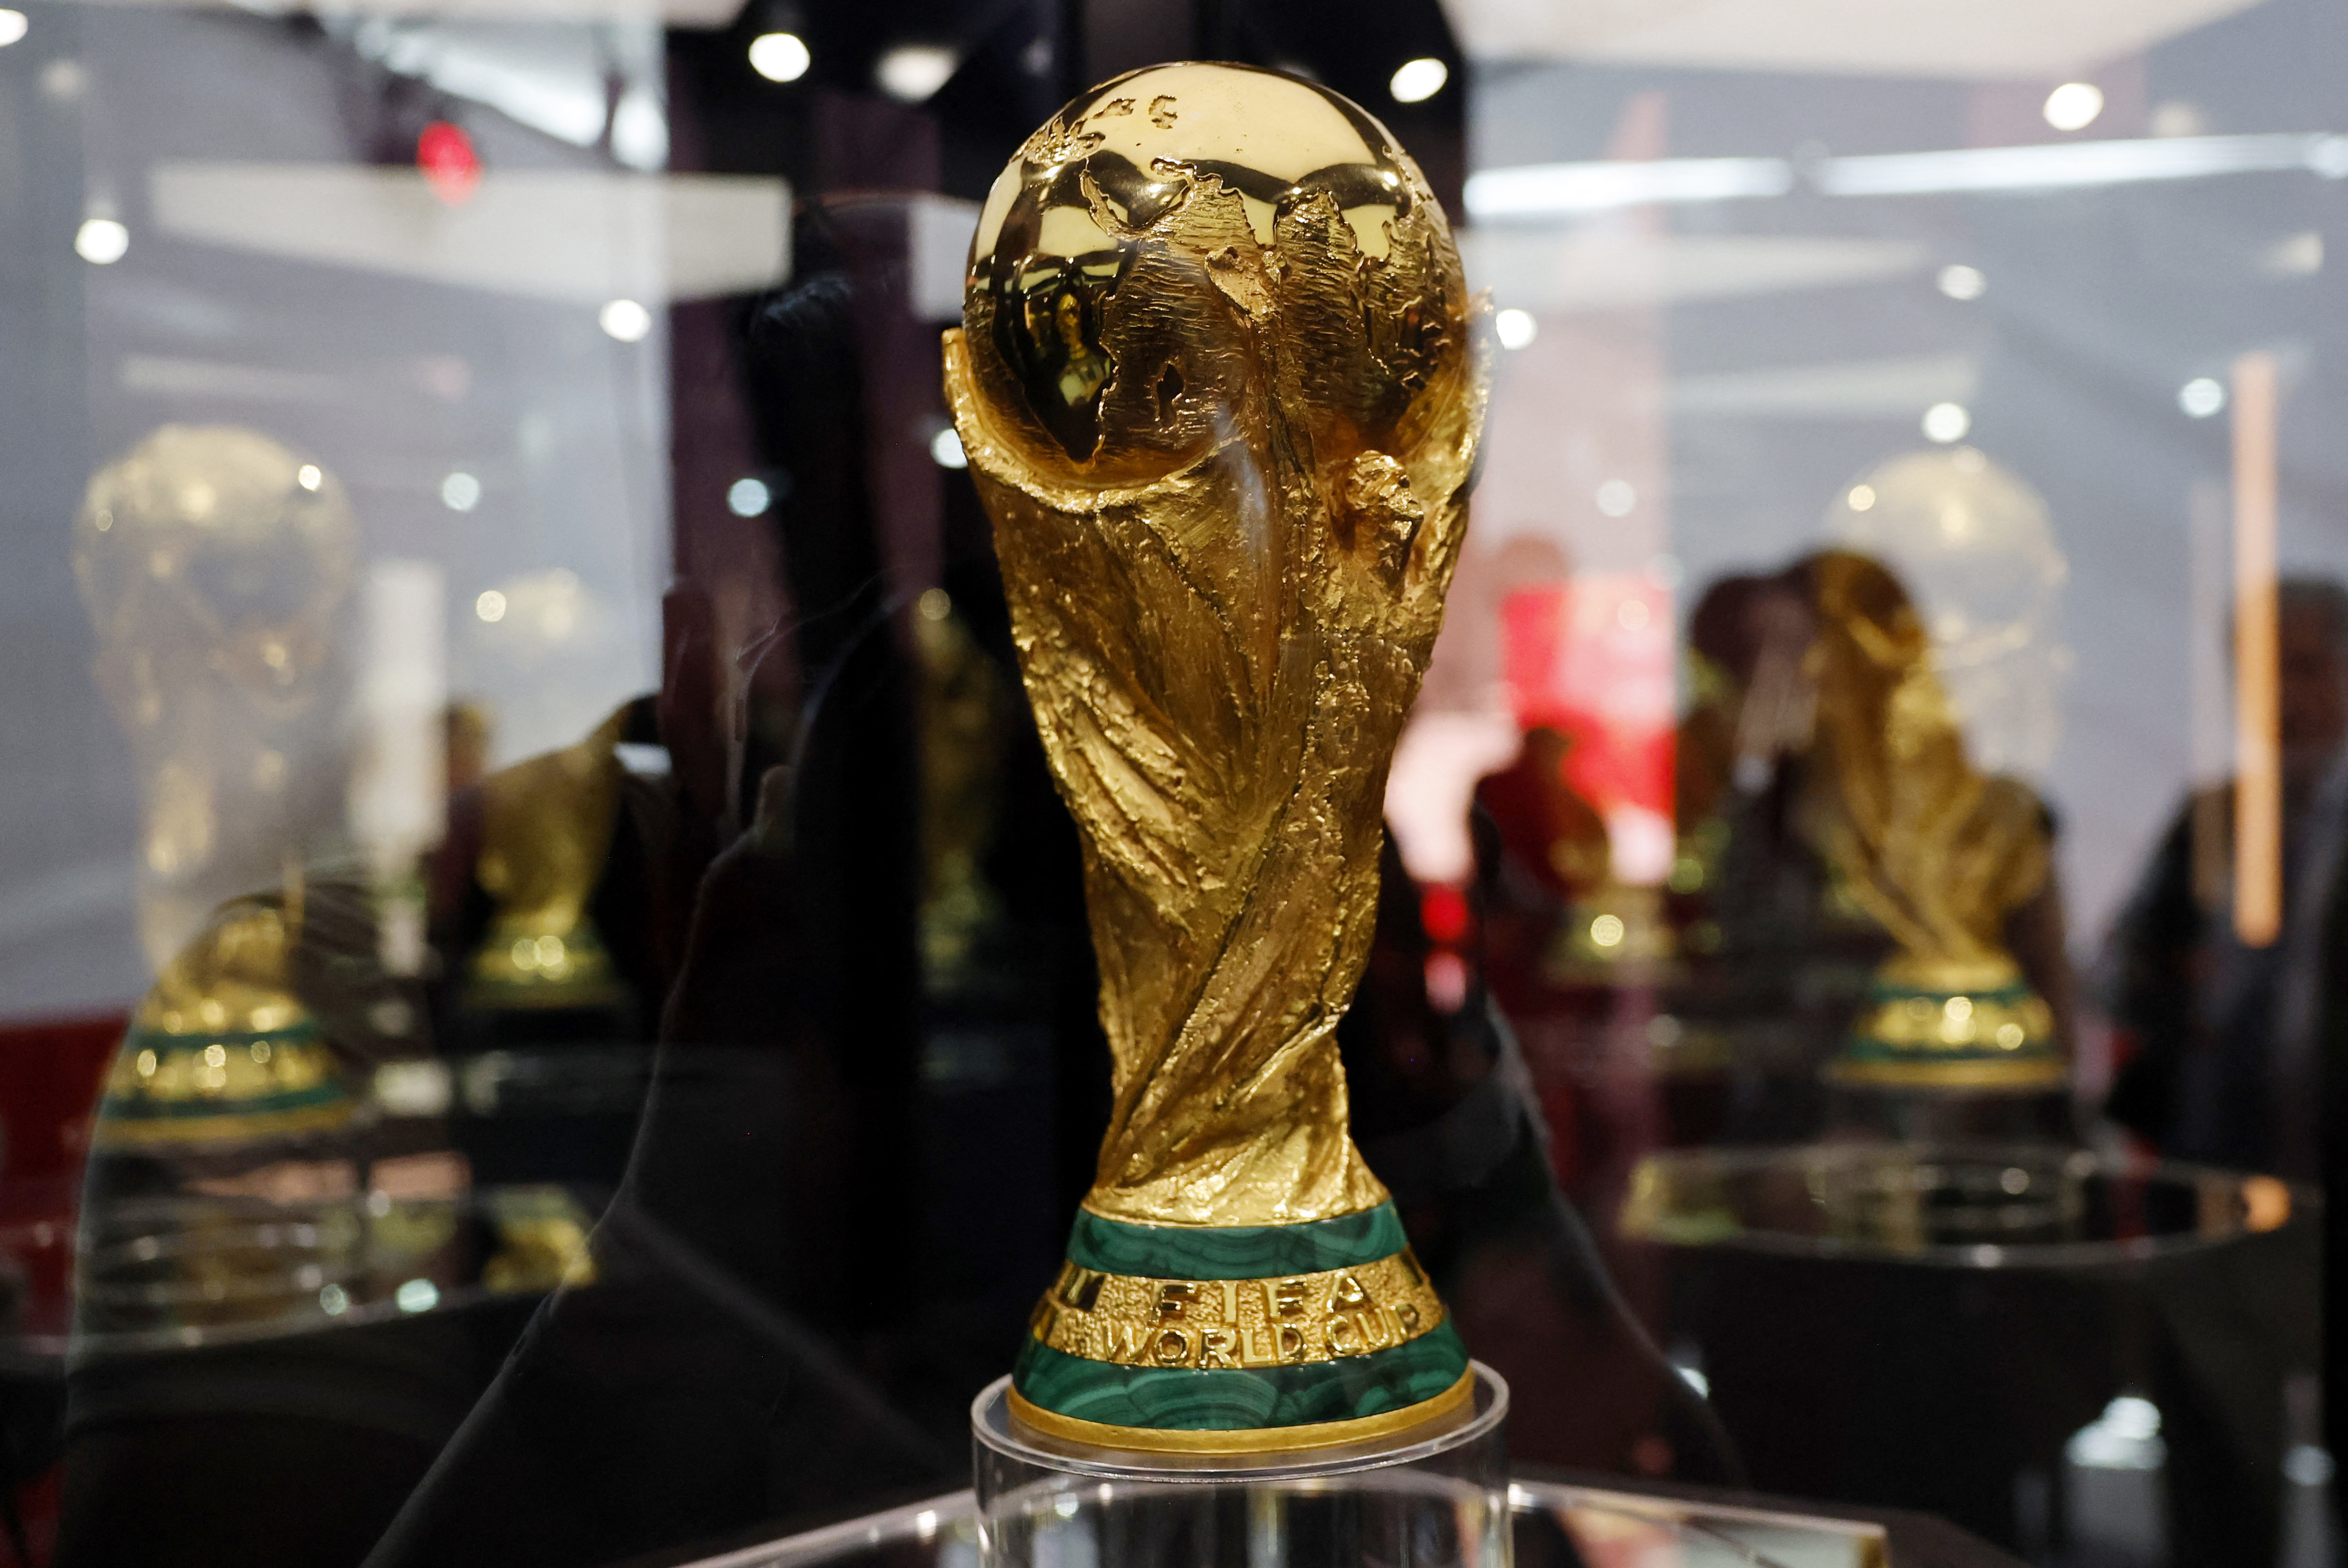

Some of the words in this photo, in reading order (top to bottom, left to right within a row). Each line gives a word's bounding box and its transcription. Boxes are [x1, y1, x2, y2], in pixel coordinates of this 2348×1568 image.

[1149, 1269, 1376, 1325] FIFA
[1104, 1322, 1307, 1369] WORLD
[1325, 1303, 1420, 1354] CUP
